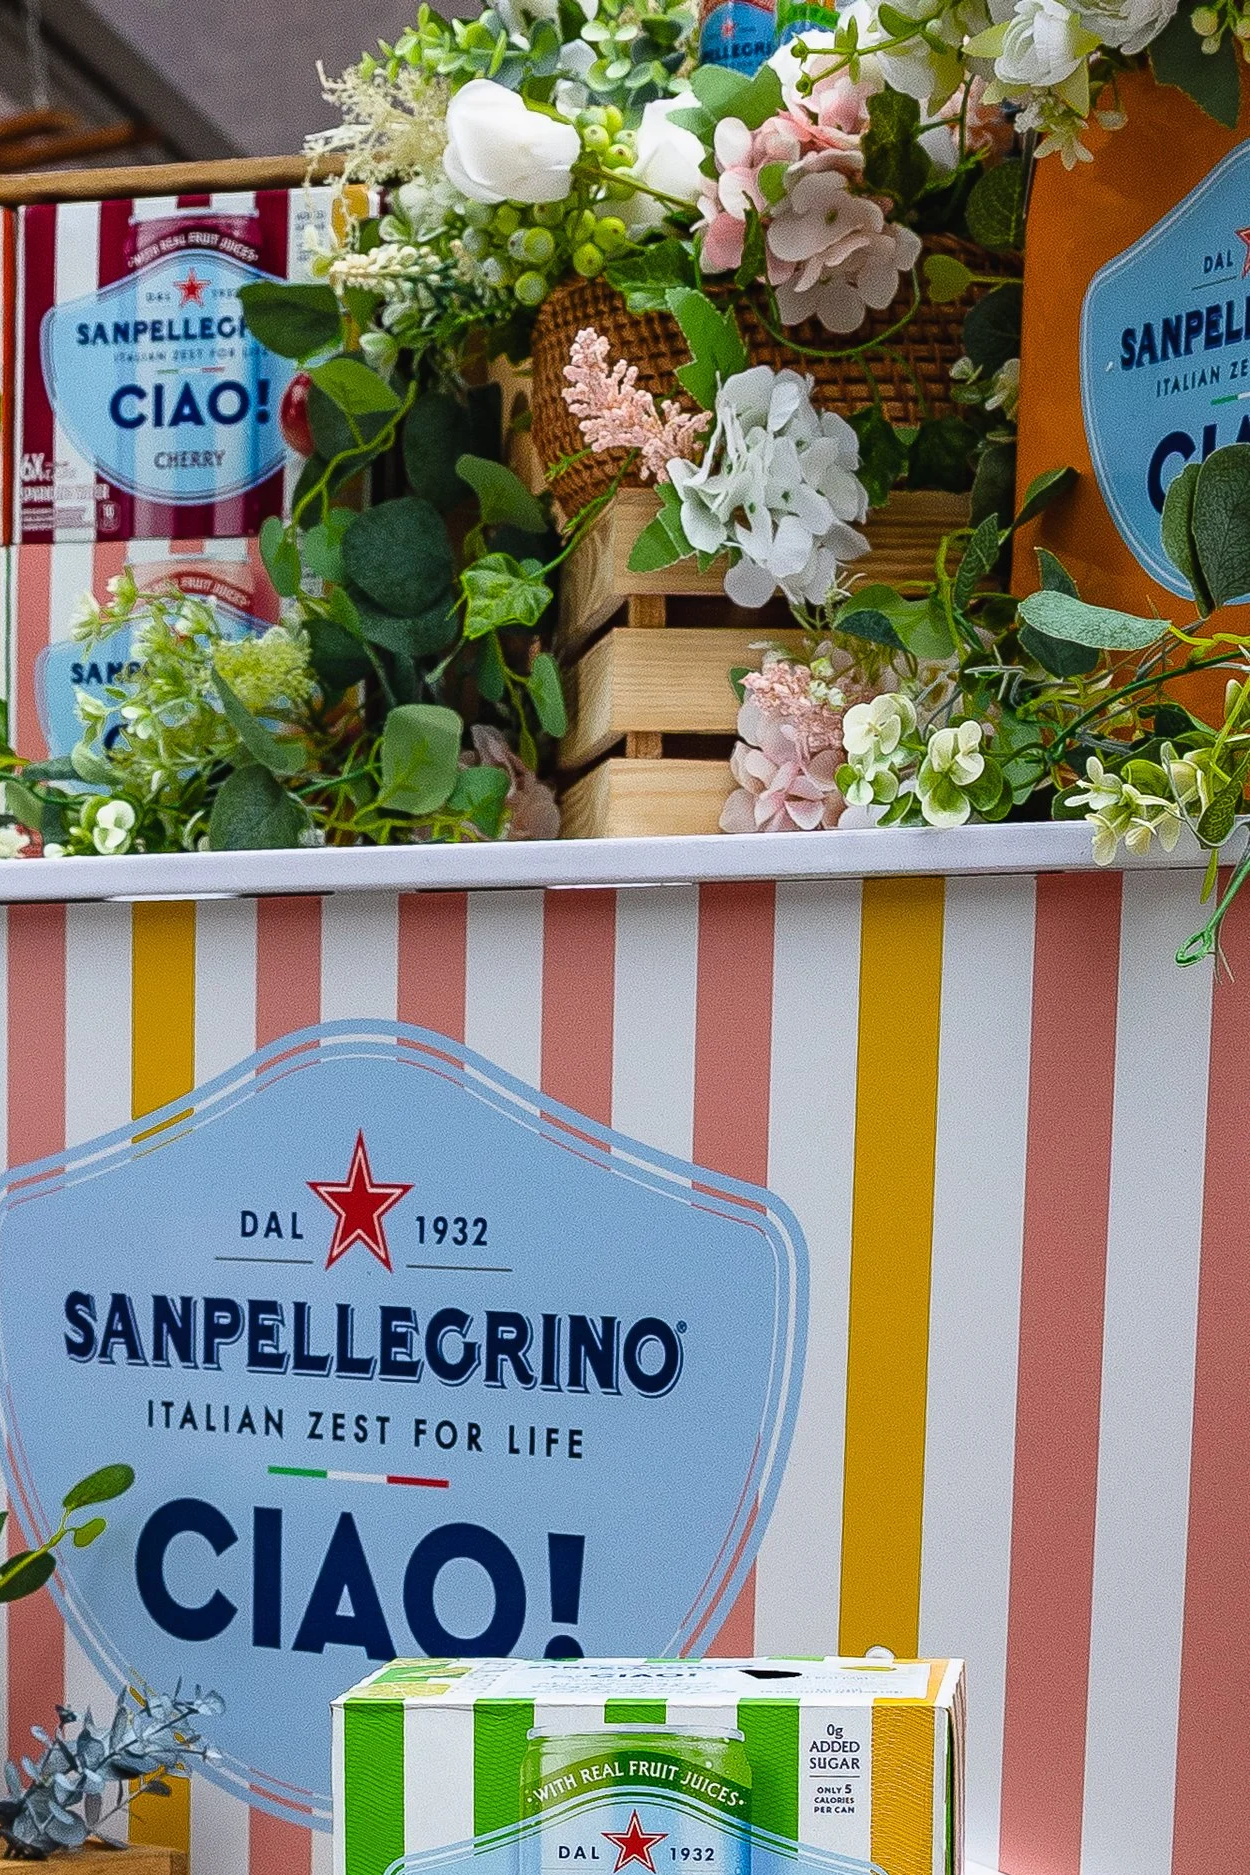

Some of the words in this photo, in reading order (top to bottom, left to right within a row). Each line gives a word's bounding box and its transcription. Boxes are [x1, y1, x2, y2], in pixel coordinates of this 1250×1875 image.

[1204, 250, 1234, 274] DAL
[76, 316, 245, 346] SANPELLEG
[1156, 365, 1220, 398] ITALIAN
[110, 378, 270, 429] CIAO!
[154, 451, 226, 469] CHERRY
[240, 1211, 305, 1240] DAL
[415, 1215, 490, 1248] 1932
[147, 1400, 285, 1439] ITALIAN
[306, 1409, 391, 1446] ZEST
[414, 1419, 484, 1453] FOR
[507, 1424, 586, 1461] LIFE
[134, 1495, 588, 1663] CIAO!
[826, 1724, 844, 1739] 0g
[809, 1740, 861, 1753] ADDED
[809, 1757, 861, 1769] SUGAR
[533, 1773, 578, 1803] WITH
[580, 1760, 624, 1783] REAL
[629, 1760, 679, 1781] FRUIT
[680, 1771, 739, 1807] JUICES
[816, 1786, 842, 1794] ONLY
[844, 1784, 852, 1794] 5
[558, 1845, 600, 1860] DAL
[670, 1847, 715, 1861] 1932
